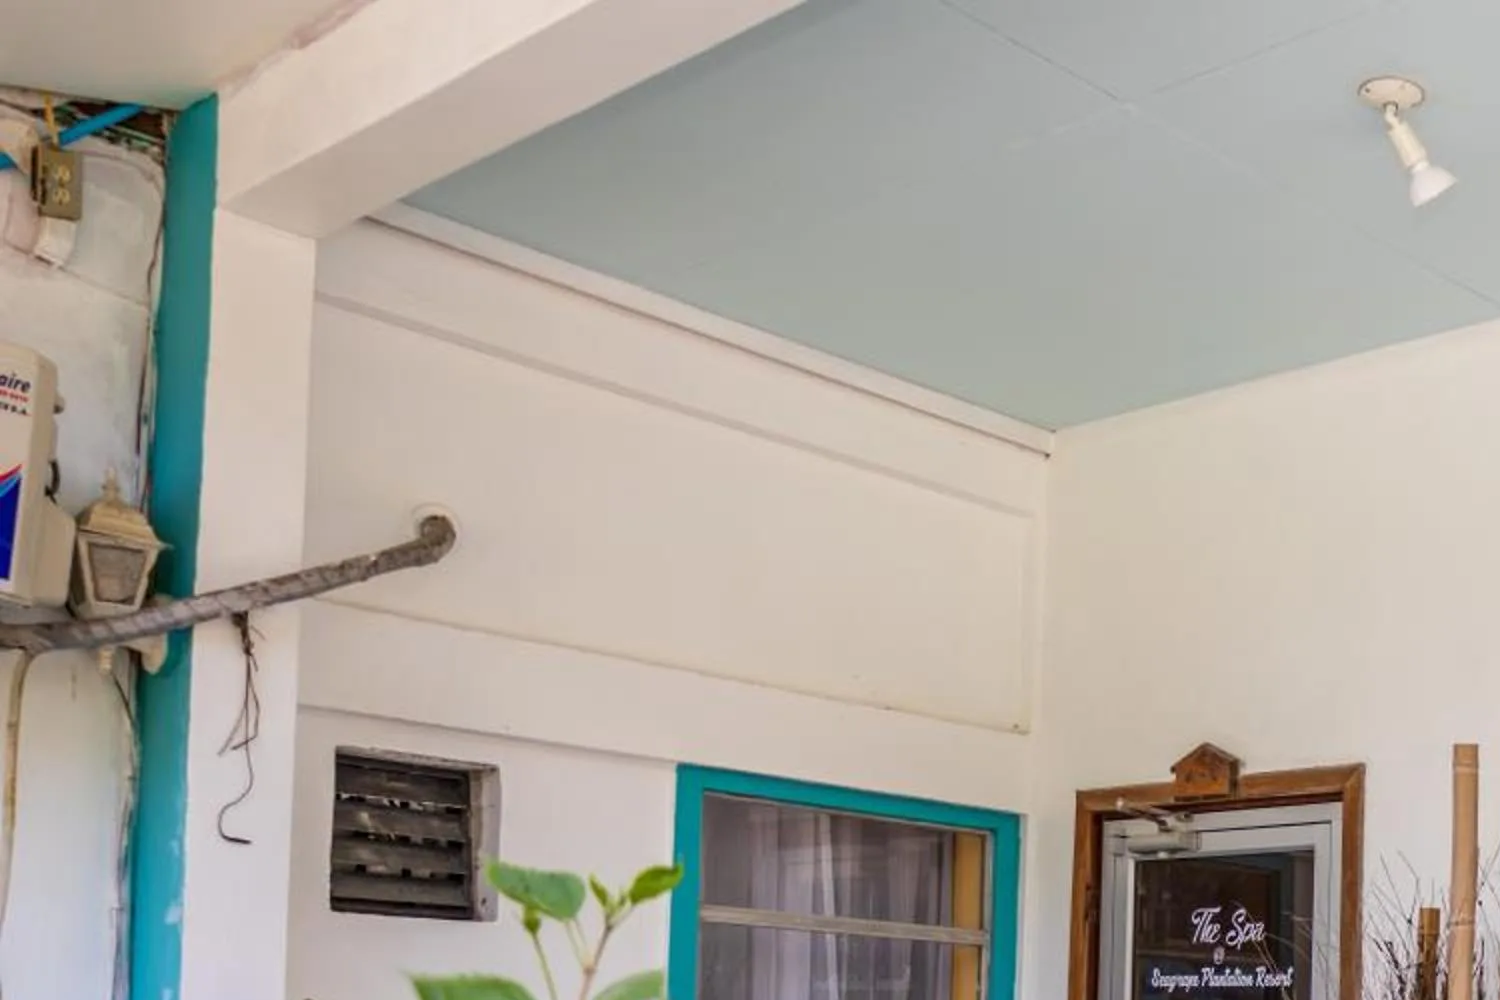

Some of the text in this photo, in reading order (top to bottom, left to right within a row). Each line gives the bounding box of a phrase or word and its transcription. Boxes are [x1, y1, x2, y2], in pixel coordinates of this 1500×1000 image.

[1191, 906, 1266, 951] The Spa
[1201, 966, 1253, 988] Plantation
[1255, 965, 1294, 989] Resort
